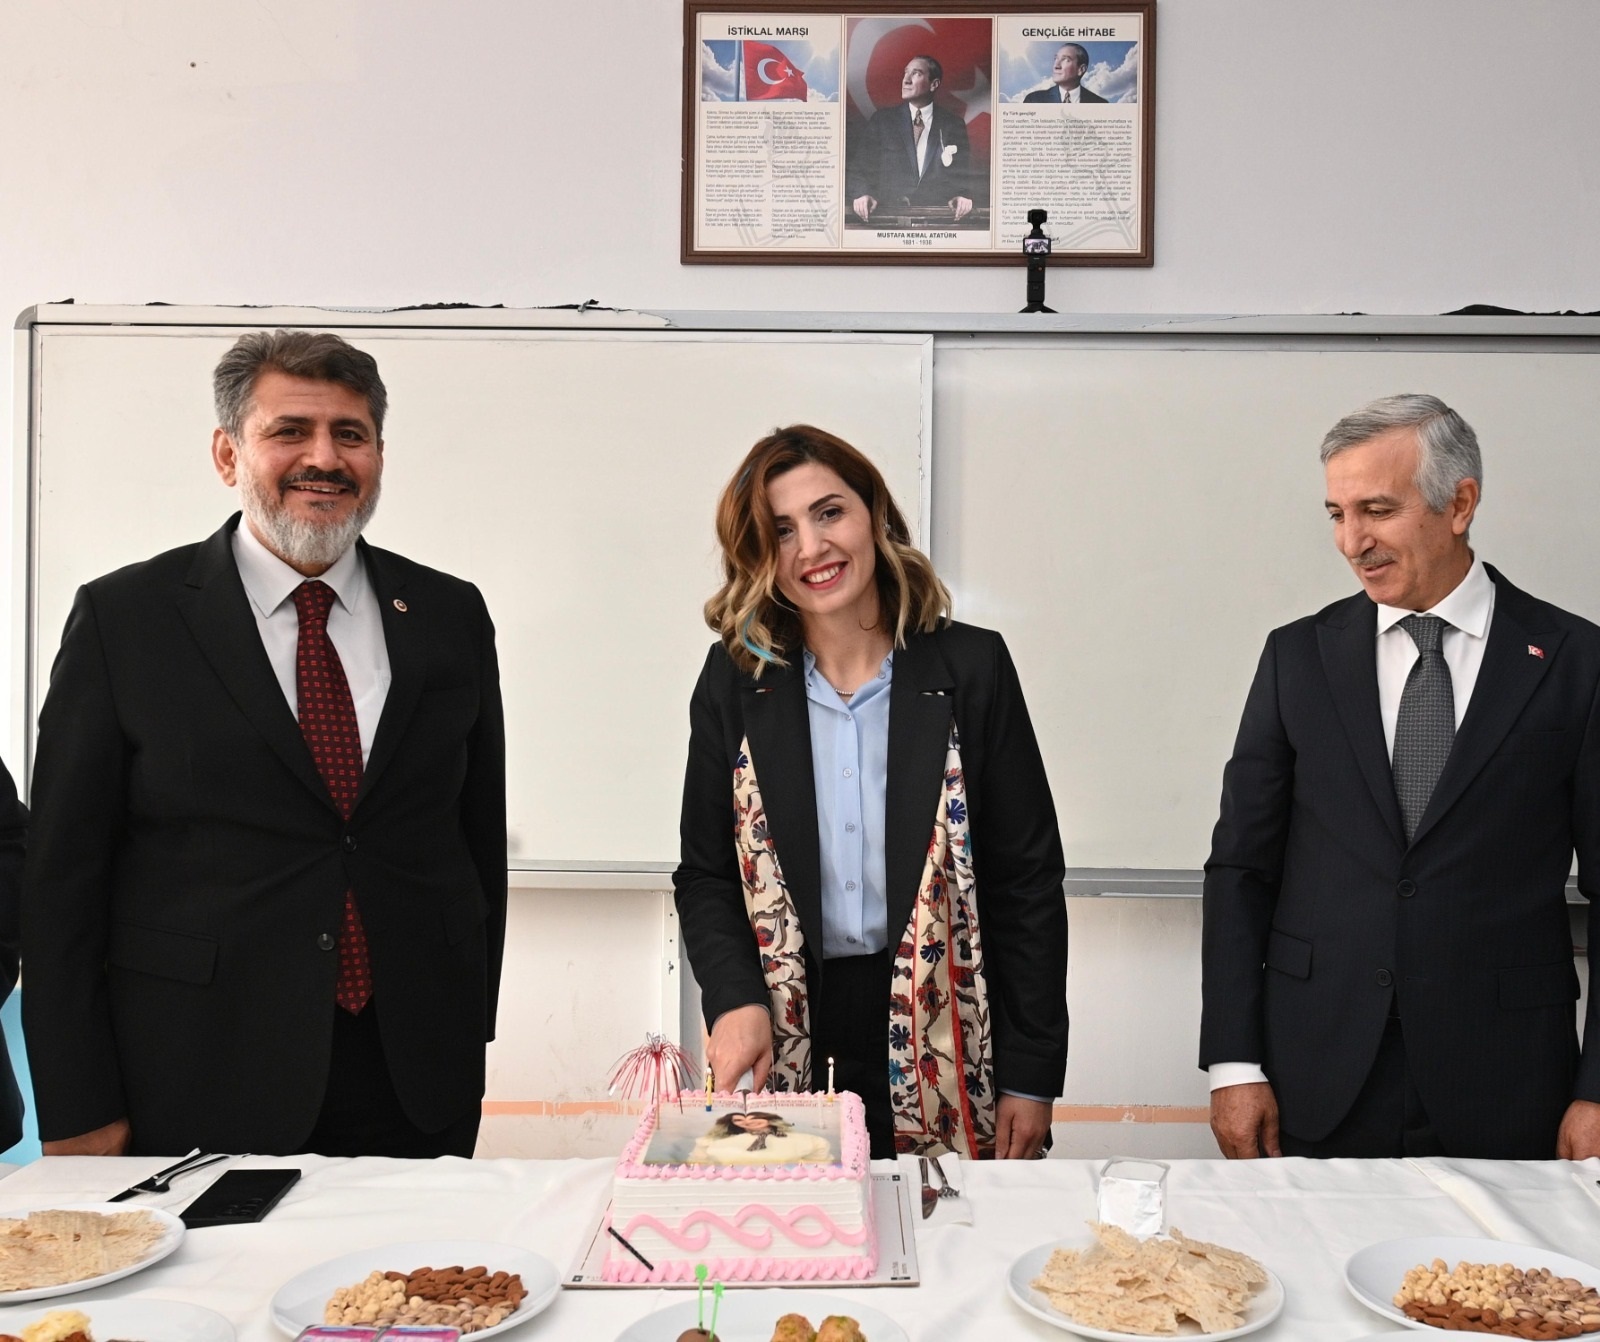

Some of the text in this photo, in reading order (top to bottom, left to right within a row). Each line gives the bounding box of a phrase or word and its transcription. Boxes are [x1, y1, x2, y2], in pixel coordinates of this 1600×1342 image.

[727, 25, 809, 38] İSTİKLAL MARŞI
[1021, 25, 1116, 39] GENÇLİĞE HİTABE
[929, 231, 957, 239] ATATÜRK
